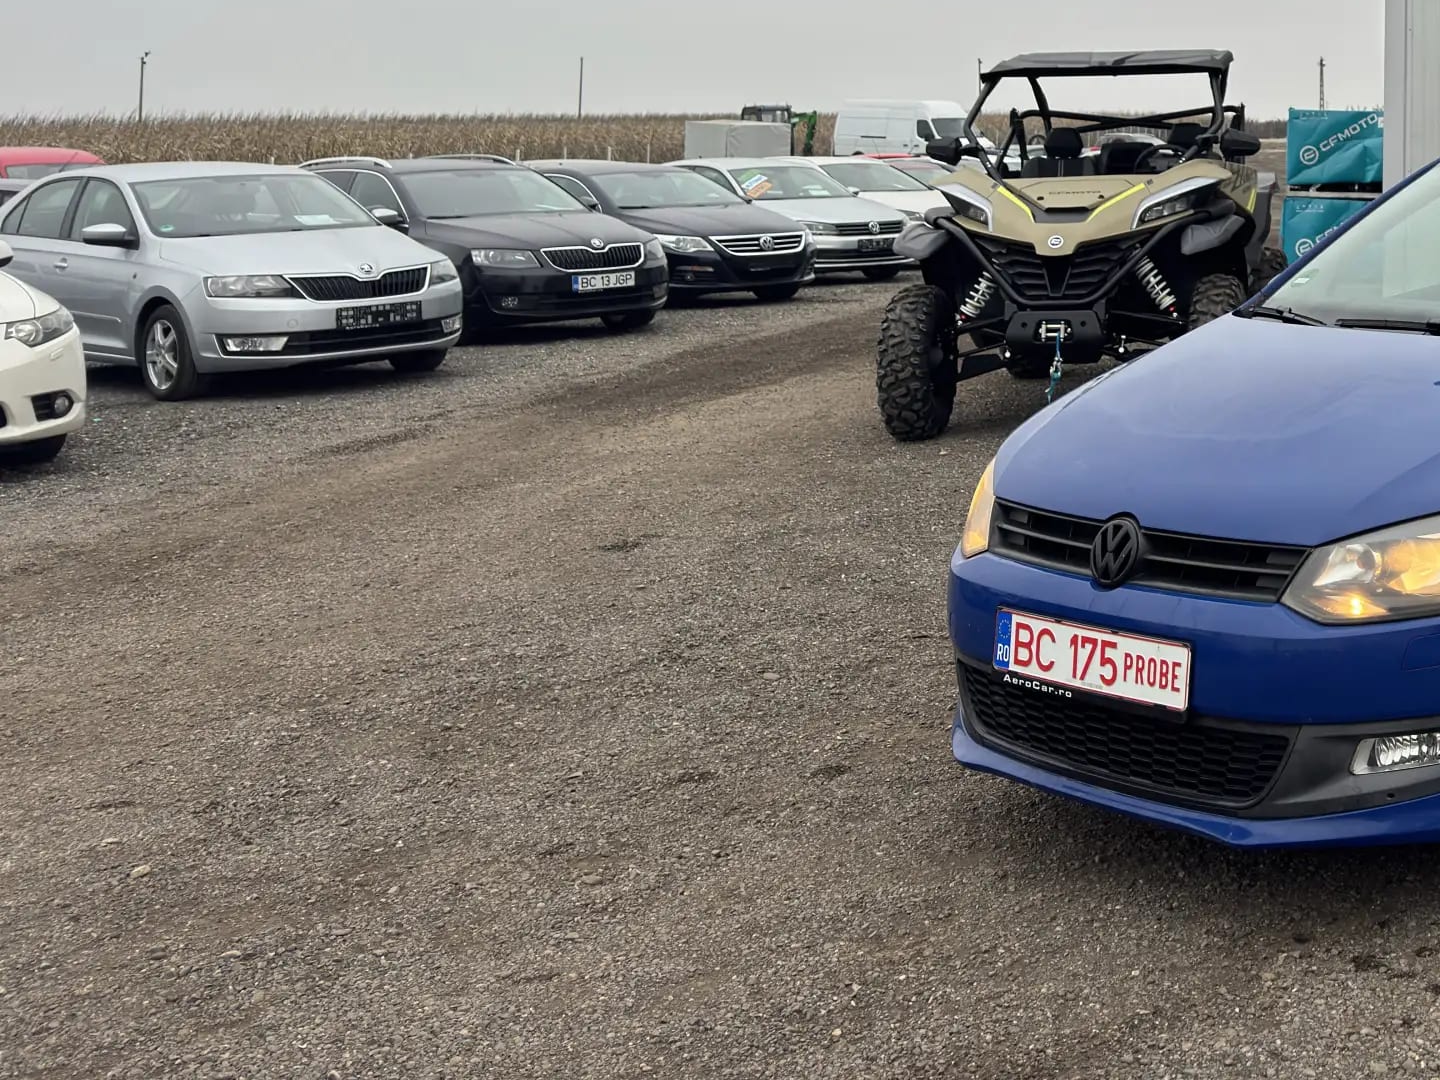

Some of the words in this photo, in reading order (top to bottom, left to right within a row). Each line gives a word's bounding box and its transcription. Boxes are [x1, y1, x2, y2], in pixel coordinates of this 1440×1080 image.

[1319, 113, 1378, 152] CFMOTO
[580, 276, 597, 289] BC
[601, 275, 611, 287] 13
[613, 273, 633, 286] JGP
[996, 643, 1010, 663] RO
[1013, 621, 1057, 672] BC
[1069, 633, 1118, 686] 175
[1123, 652, 1182, 692] PROBE
[1003, 674, 1072, 698] AeroCar.ro
